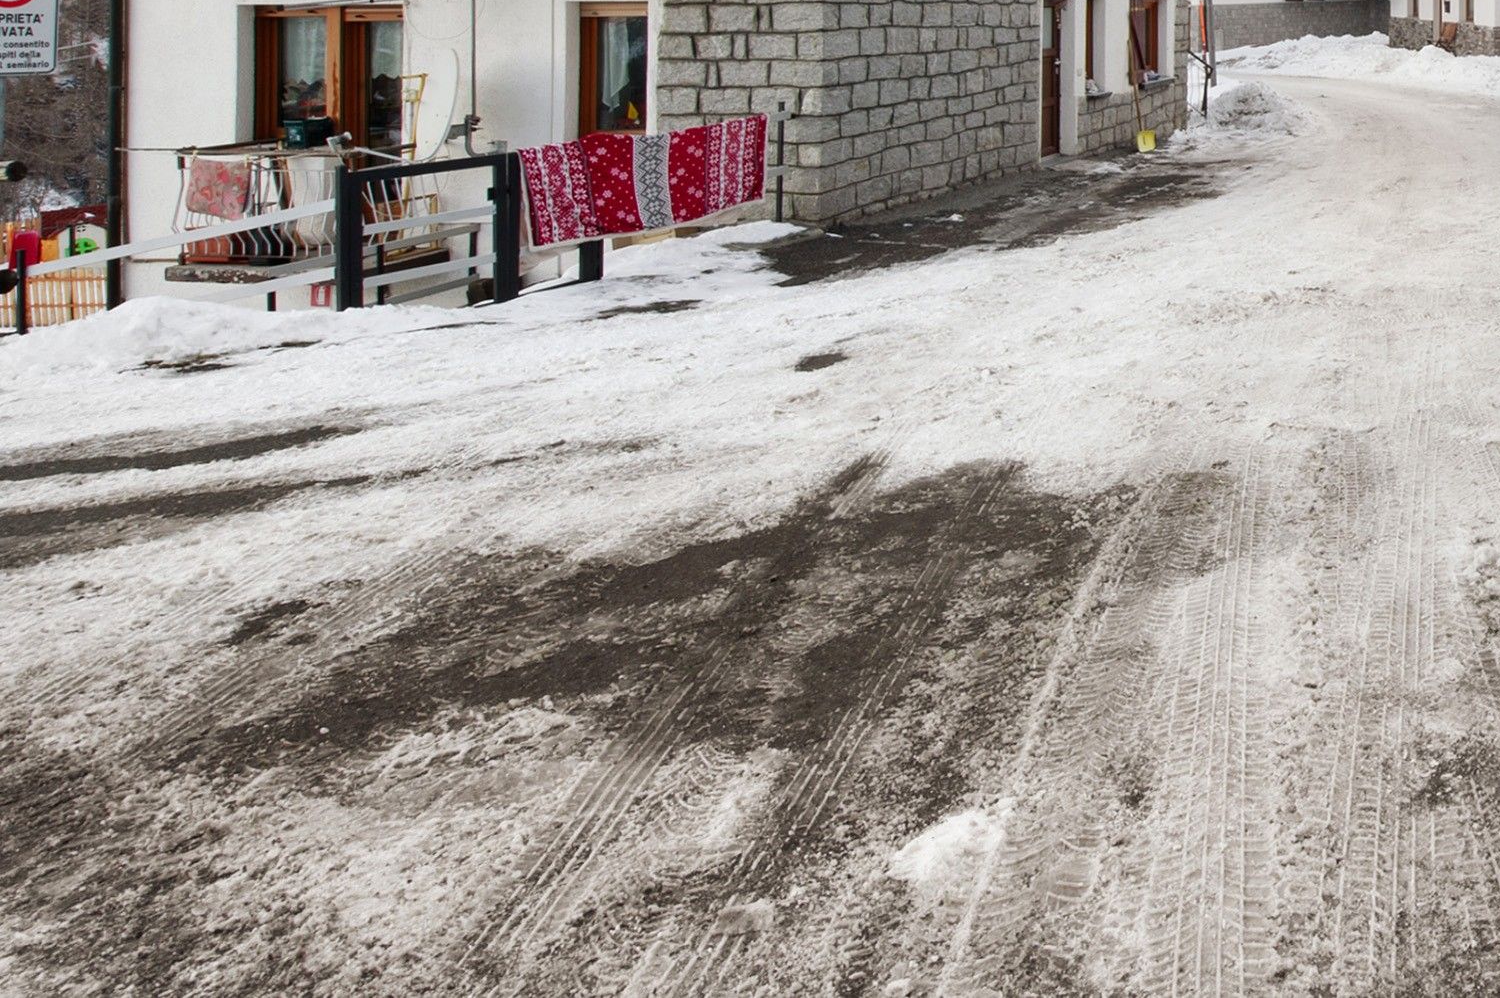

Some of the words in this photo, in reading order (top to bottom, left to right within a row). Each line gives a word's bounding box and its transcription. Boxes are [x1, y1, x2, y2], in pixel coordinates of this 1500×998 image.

[0, 26, 34, 37] VATA
[3, 40, 50, 48] consentito
[0, 51, 17, 60] piti
[19, 51, 41, 59] della
[7, 60, 49, 69] seminario
